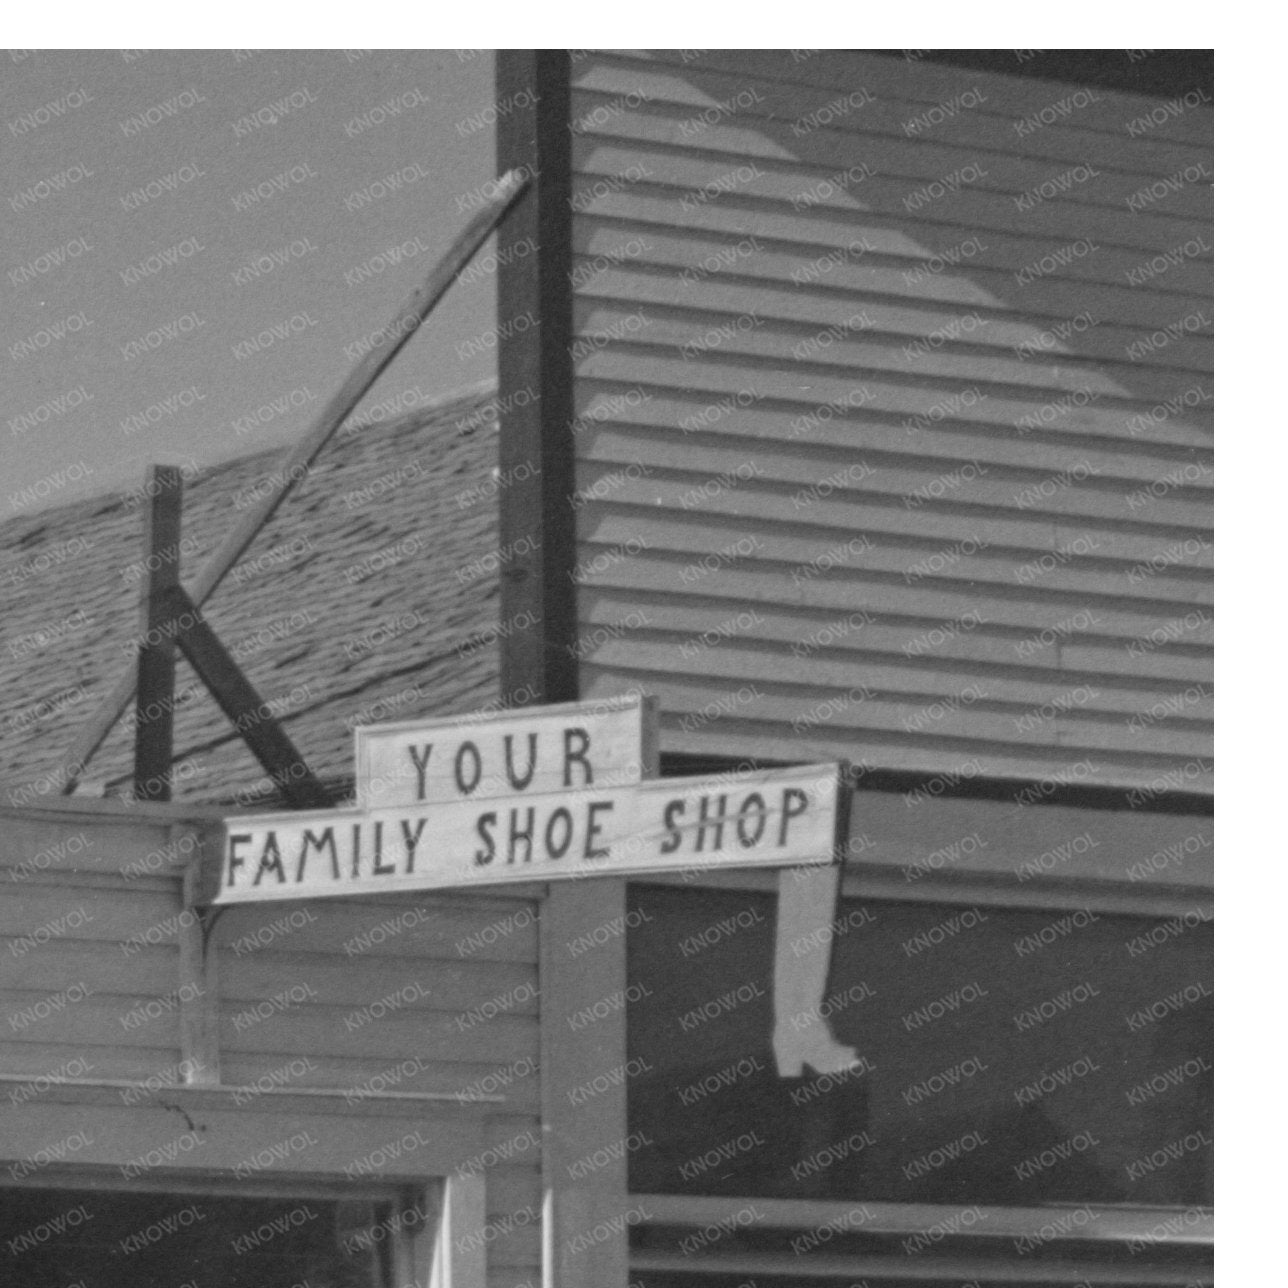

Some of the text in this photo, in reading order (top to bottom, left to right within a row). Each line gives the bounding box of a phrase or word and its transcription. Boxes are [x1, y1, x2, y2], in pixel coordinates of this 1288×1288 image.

[408, 727, 593, 800] YOUR
[226, 788, 808, 887] FAMILY SHOE SHOP
